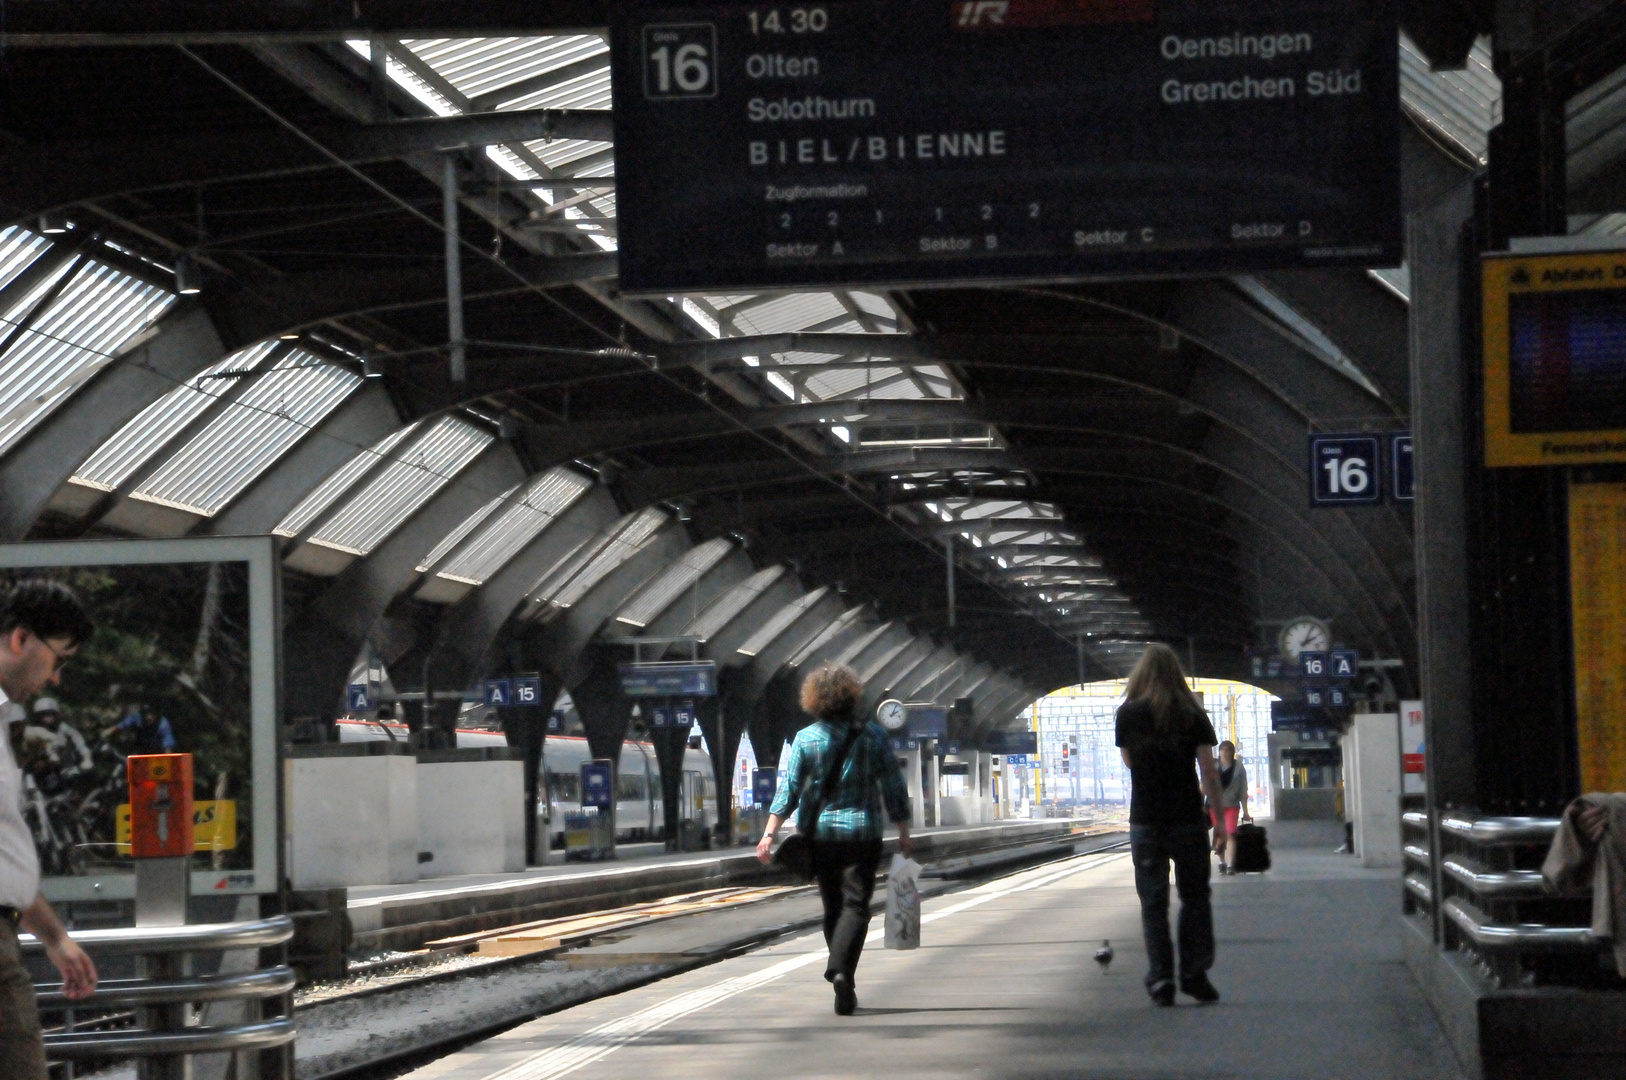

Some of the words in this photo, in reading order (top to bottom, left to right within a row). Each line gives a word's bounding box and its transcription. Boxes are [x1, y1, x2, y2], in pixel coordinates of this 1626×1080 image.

[749, 8, 828, 34] 14.30
[1161, 31, 1312, 59] Oensingen
[651, 44, 709, 92] 16
[746, 54, 820, 78] Olten
[1161, 75, 1295, 103] Grenchen
[1306, 69, 1362, 96] Süd
[747, 96, 876, 122] Solothurn
[766, 183, 867, 201] Zugformation
[781, 213, 792, 228] 2
[828, 210, 839, 226] 2
[875, 208, 883, 223] 1
[935, 207, 943, 221] 1
[982, 205, 993, 219] 2
[1029, 203, 1039, 217] 2
[1074, 229, 1127, 246] Sektor
[1141, 228, 1153, 242] C
[1231, 222, 1285, 239] Sektor
[766, 243, 818, 258] Sektor
[832, 241, 844, 255] A
[920, 237, 972, 252] Sektor
[985, 235, 998, 249] B
[1613, 265, 1626, 279] D
[1542, 439, 1626, 456] Fernverke
[1324, 457, 1368, 494] 16
[1305, 660, 1322, 674] 16
[1338, 659, 1351, 673] A
[356, 694, 368, 707] A
[492, 688, 503, 702] A
[517, 687, 534, 701] 15
[1307, 693, 1320, 704] 16
[1333, 692, 1343, 704] B
[676, 712, 689, 724] 15
[908, 741, 916, 749] 15
